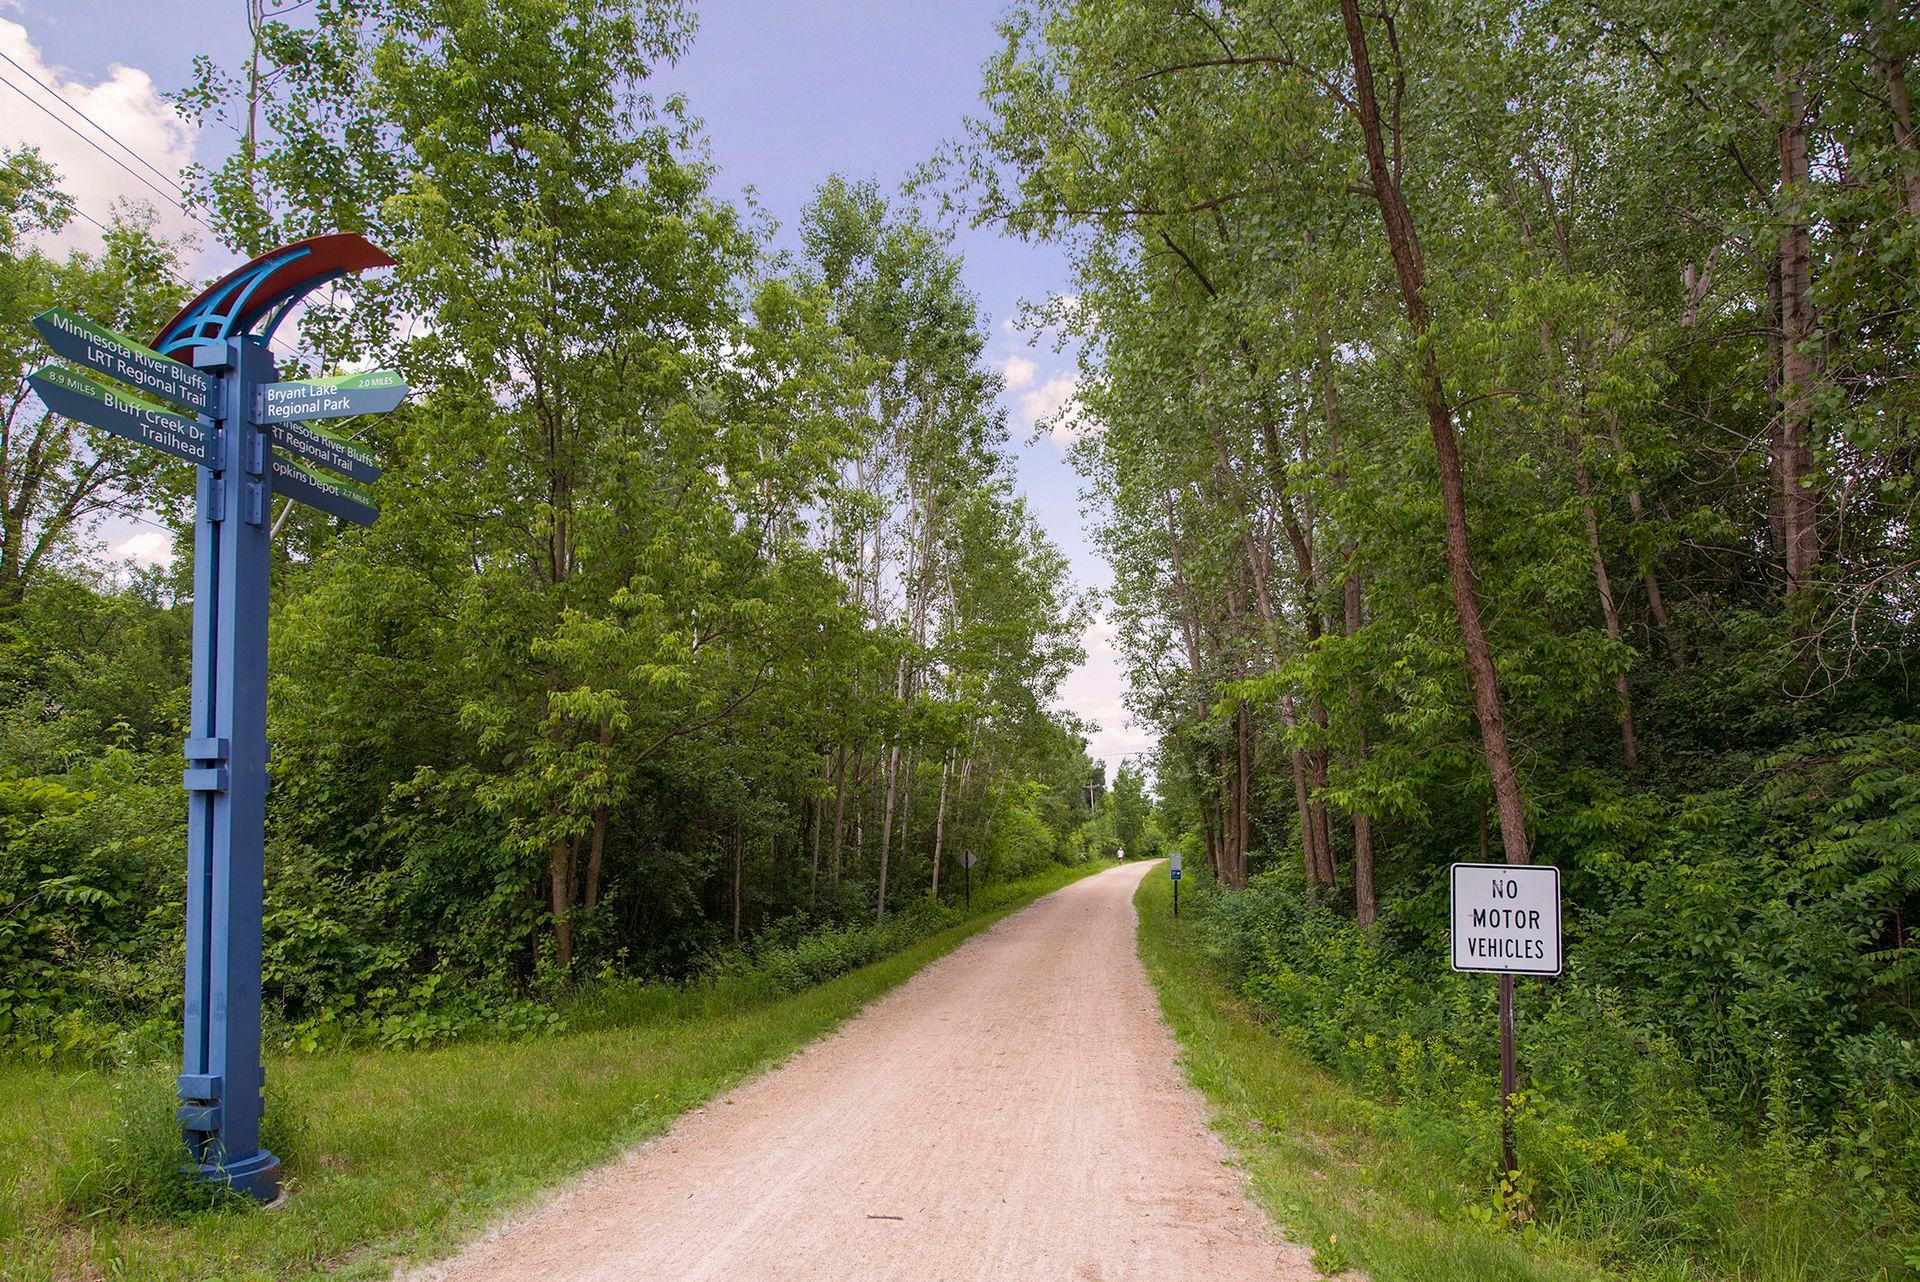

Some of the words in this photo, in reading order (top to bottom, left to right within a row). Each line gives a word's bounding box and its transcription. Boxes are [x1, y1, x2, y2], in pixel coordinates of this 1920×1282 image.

[53, 313, 130, 358] Minnesota
[135, 350, 168, 374] River
[172, 366, 207, 392] Bluffs
[49, 371, 65, 384] 8.9
[67, 377, 96, 396] MILES
[87, 346, 114, 368] LRT
[117, 360, 176, 395] Regional
[179, 385, 206, 407] Trail
[371, 376, 393, 387] MILES
[267, 387, 306, 403] Bryant
[310, 384, 338, 396] Lake
[104, 393, 142, 417] Bluff
[146, 411, 185, 435] Creek
[189, 426, 205, 442] Dr
[267, 400, 320, 419] Regional
[324, 397, 350, 411] Park
[140, 423, 205, 458] Trailhead
[287, 432, 330, 461] Regional
[332, 453, 353, 471] Trail
[322, 435, 345, 454] River
[347, 446, 373, 467] Bluffs
[273, 462, 307, 483] opkins
[309, 477, 339, 497] Depot
[1492, 879, 1518, 899] NO
[1473, 908, 1540, 930] MOTOR
[1468, 937, 1544, 960] VEHICLES
